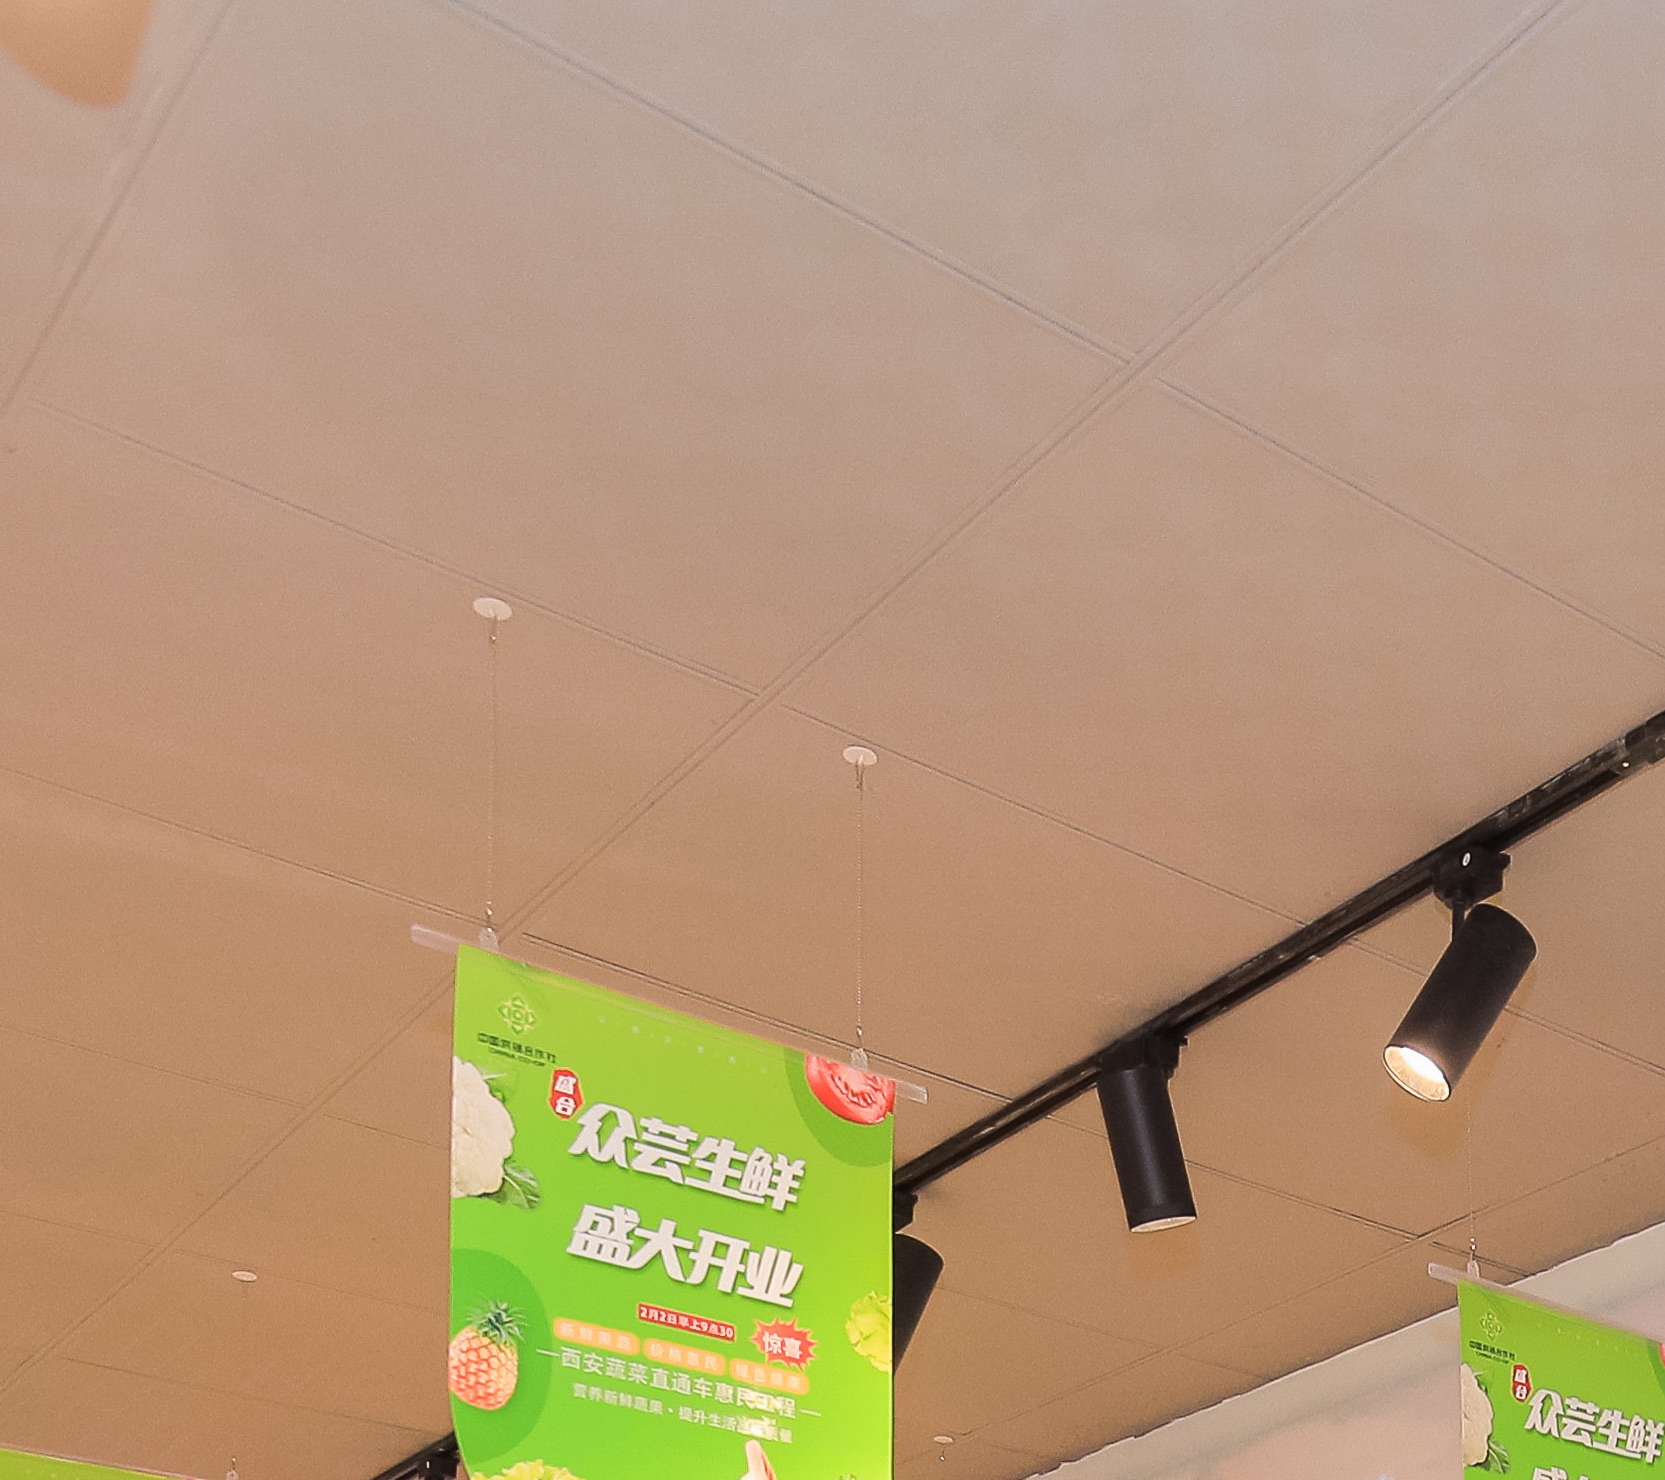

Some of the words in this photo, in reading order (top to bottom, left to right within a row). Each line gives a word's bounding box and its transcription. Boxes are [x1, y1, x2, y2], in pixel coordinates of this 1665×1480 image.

[568, 1103, 807, 1211] 众芸生鲜
[566, 1204, 804, 1307] 盛大开业
[762, 1331, 803, 1360] 惊喜
[1523, 1389, 1665, 1464] 众芸生鲜
